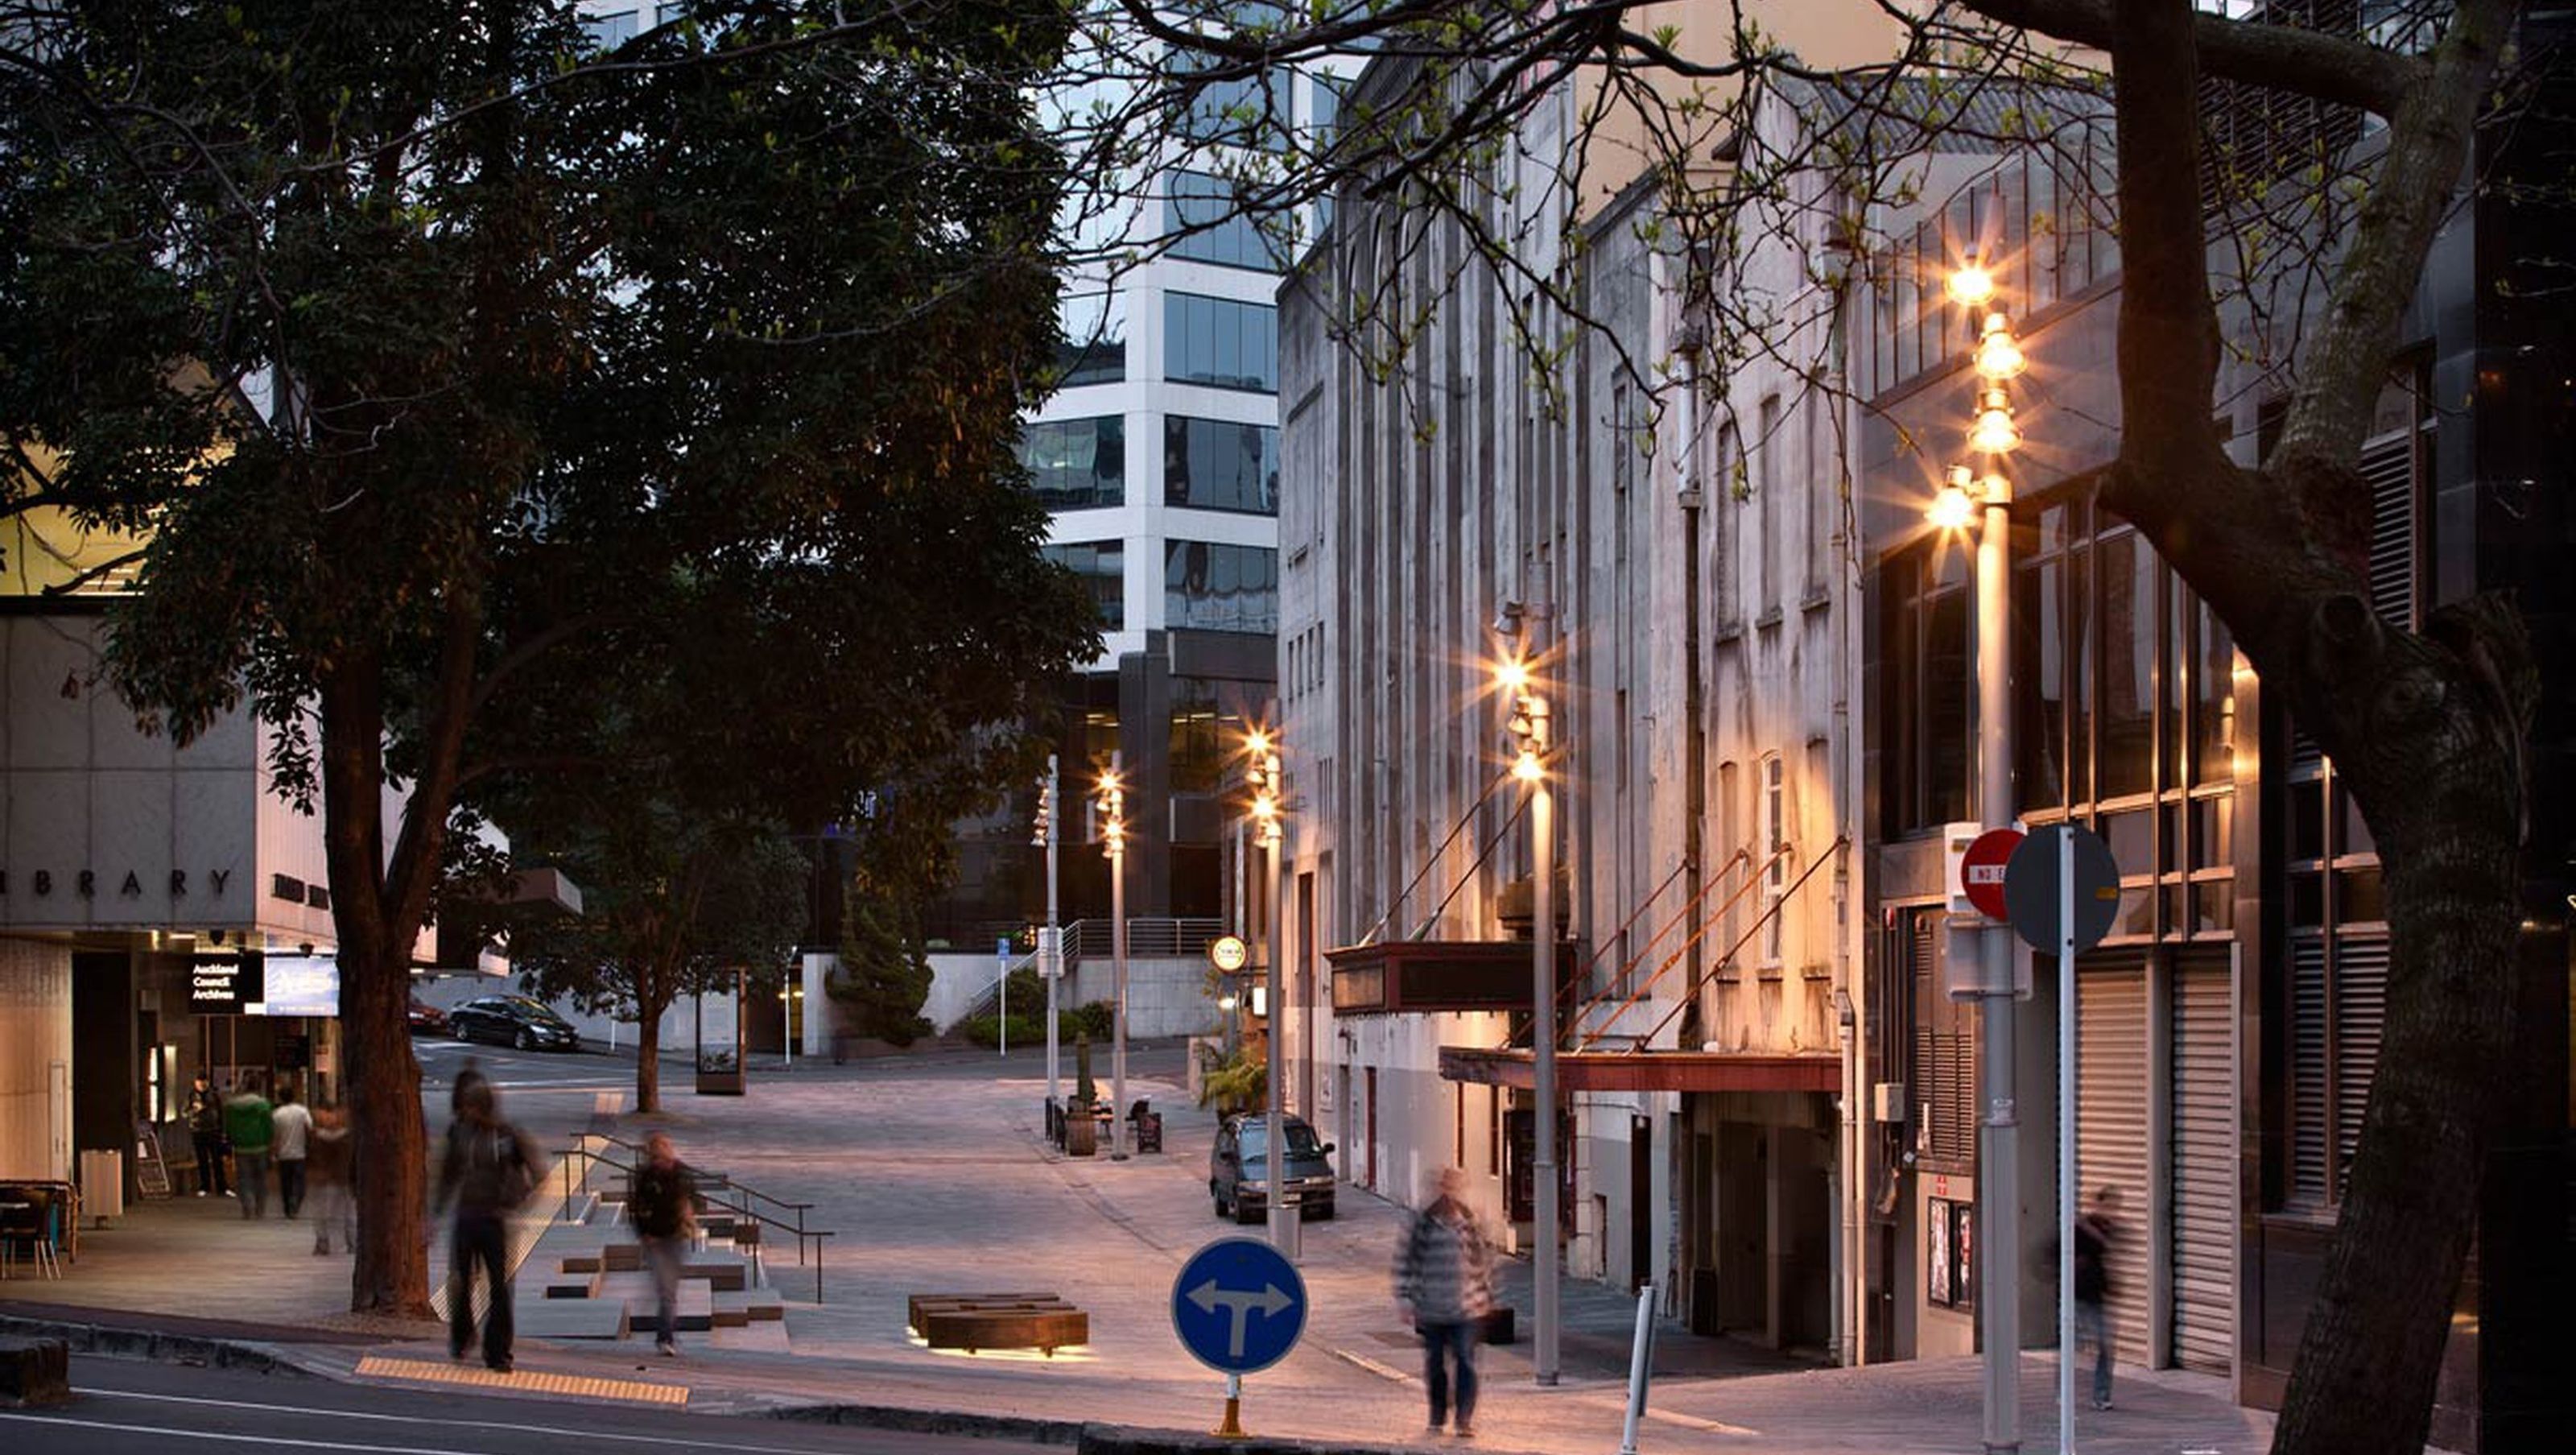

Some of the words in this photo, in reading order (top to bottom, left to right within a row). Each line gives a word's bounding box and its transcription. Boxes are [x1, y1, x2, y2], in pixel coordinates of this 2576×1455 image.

[1977, 868, 1991, 880] NO
[193, 964, 239, 975] Auckland
[193, 977, 230, 987] Council
[193, 990, 235, 999] Archives
